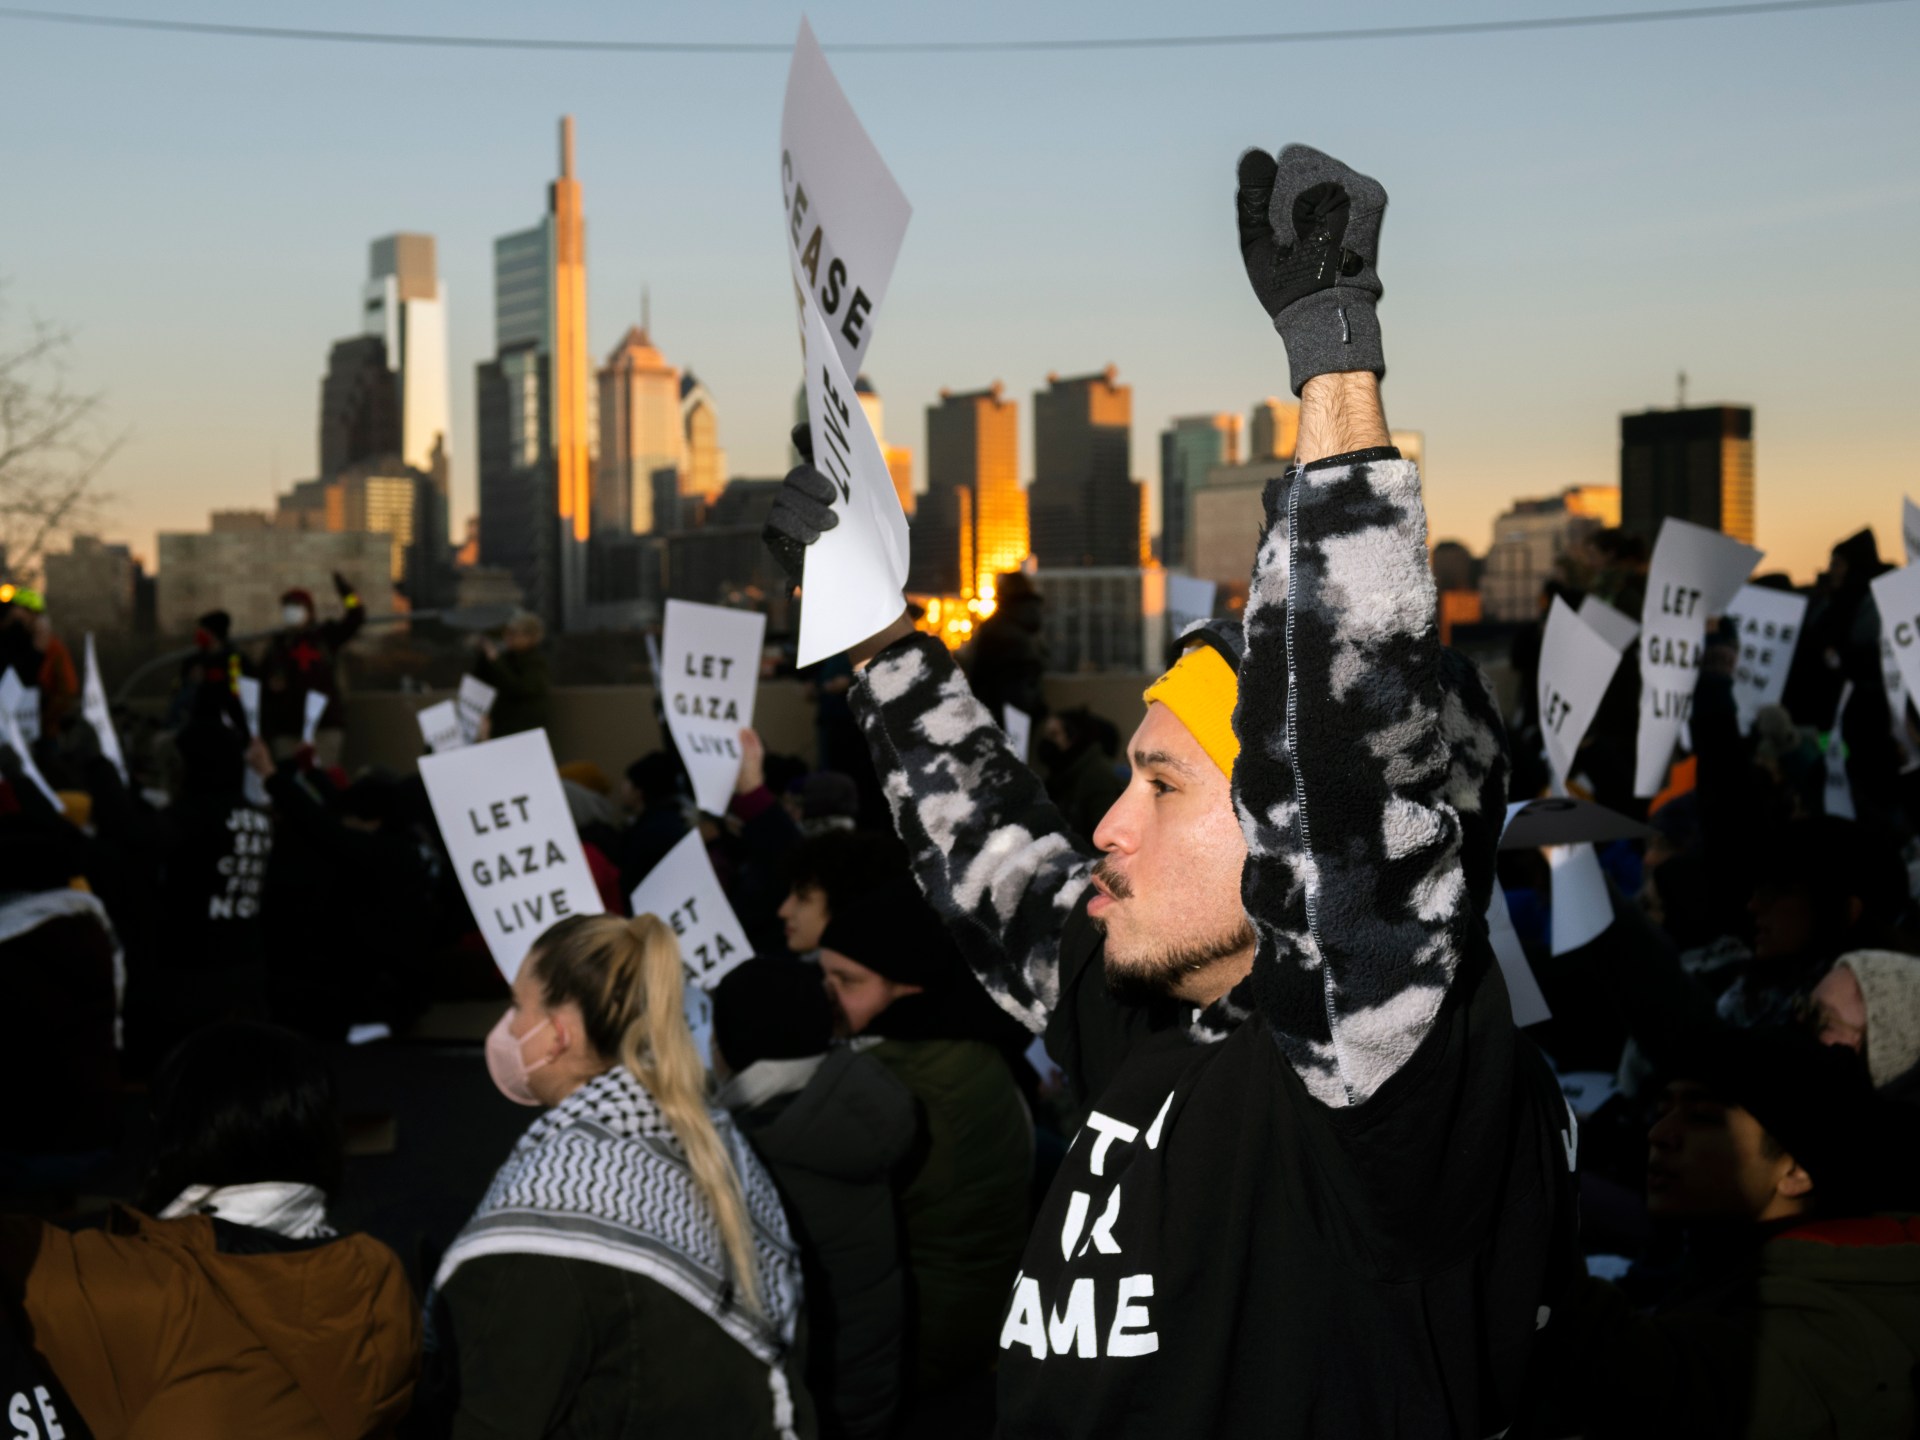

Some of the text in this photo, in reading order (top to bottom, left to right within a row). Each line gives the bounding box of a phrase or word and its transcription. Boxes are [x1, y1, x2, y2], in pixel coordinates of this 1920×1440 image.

[781, 147, 872, 350] CEASE
[823, 364, 851, 505] LIVE
[1661, 584, 1703, 617] LET
[685, 651, 733, 680] LET
[673, 690, 741, 723] GAZA
[1542, 681, 1572, 737] LET
[688, 732, 738, 758] LIVE
[468, 793, 530, 836] LET
[471, 838, 567, 888] GAZA
[493, 887, 572, 935] LIVE
[669, 895, 699, 936] ET
[682, 931, 736, 983] AZA
[1000, 1269, 1160, 1361] AME
